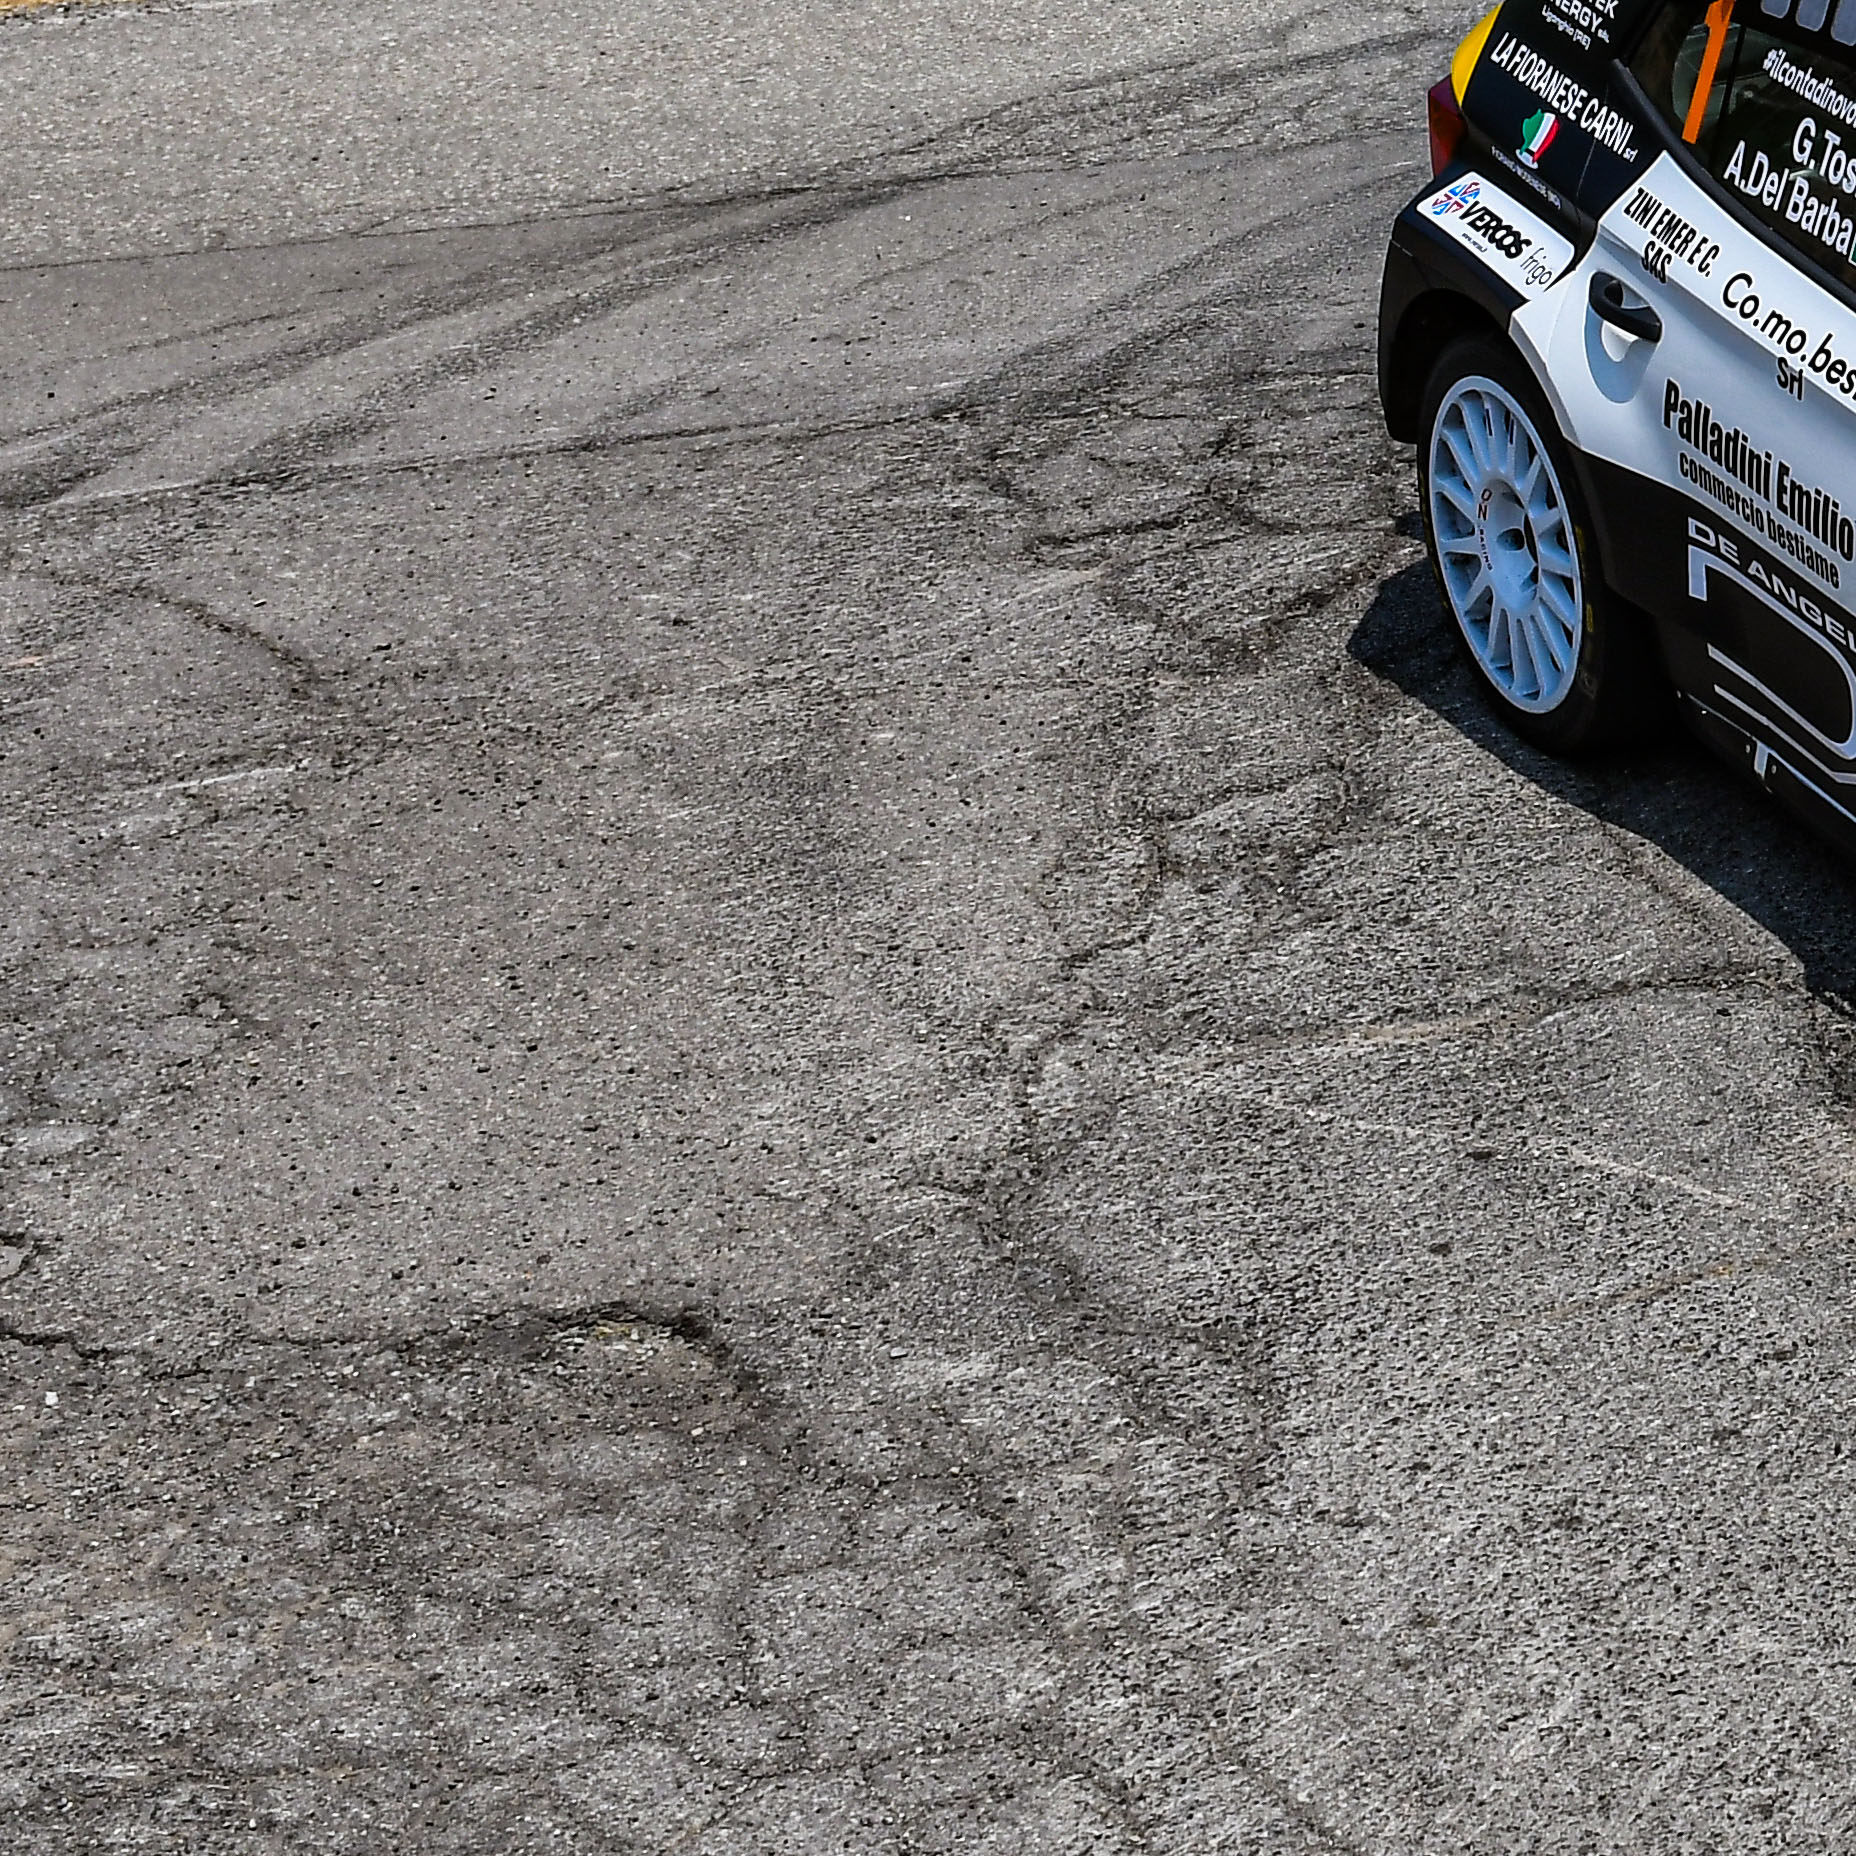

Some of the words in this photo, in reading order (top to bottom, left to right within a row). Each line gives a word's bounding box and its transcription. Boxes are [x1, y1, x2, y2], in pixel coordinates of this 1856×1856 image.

[1490, 31, 1518, 68] LA
[1506, 43, 1589, 122] FIORANESE
[1579, 98, 1635, 156] CARNI
[1623, 187, 1662, 229] ZINI
[1651, 208, 1697, 258] EMER
[1724, 139, 1788, 216] A.Del
[1787, 176, 1854, 257] Barba
[1459, 200, 1533, 259] VERCOS
[1519, 246, 1553, 286] frigo
[1641, 240, 1672, 284] SAS
[1776, 355, 1804, 402] Srl
[1662, 377, 1774, 502] Palladini
[1776, 459, 1855, 562] Emilio
[1679, 452, 1765, 533] commercio
[1764, 497, 1842, 590] bestiame
[1688, 517, 1742, 567] DE
